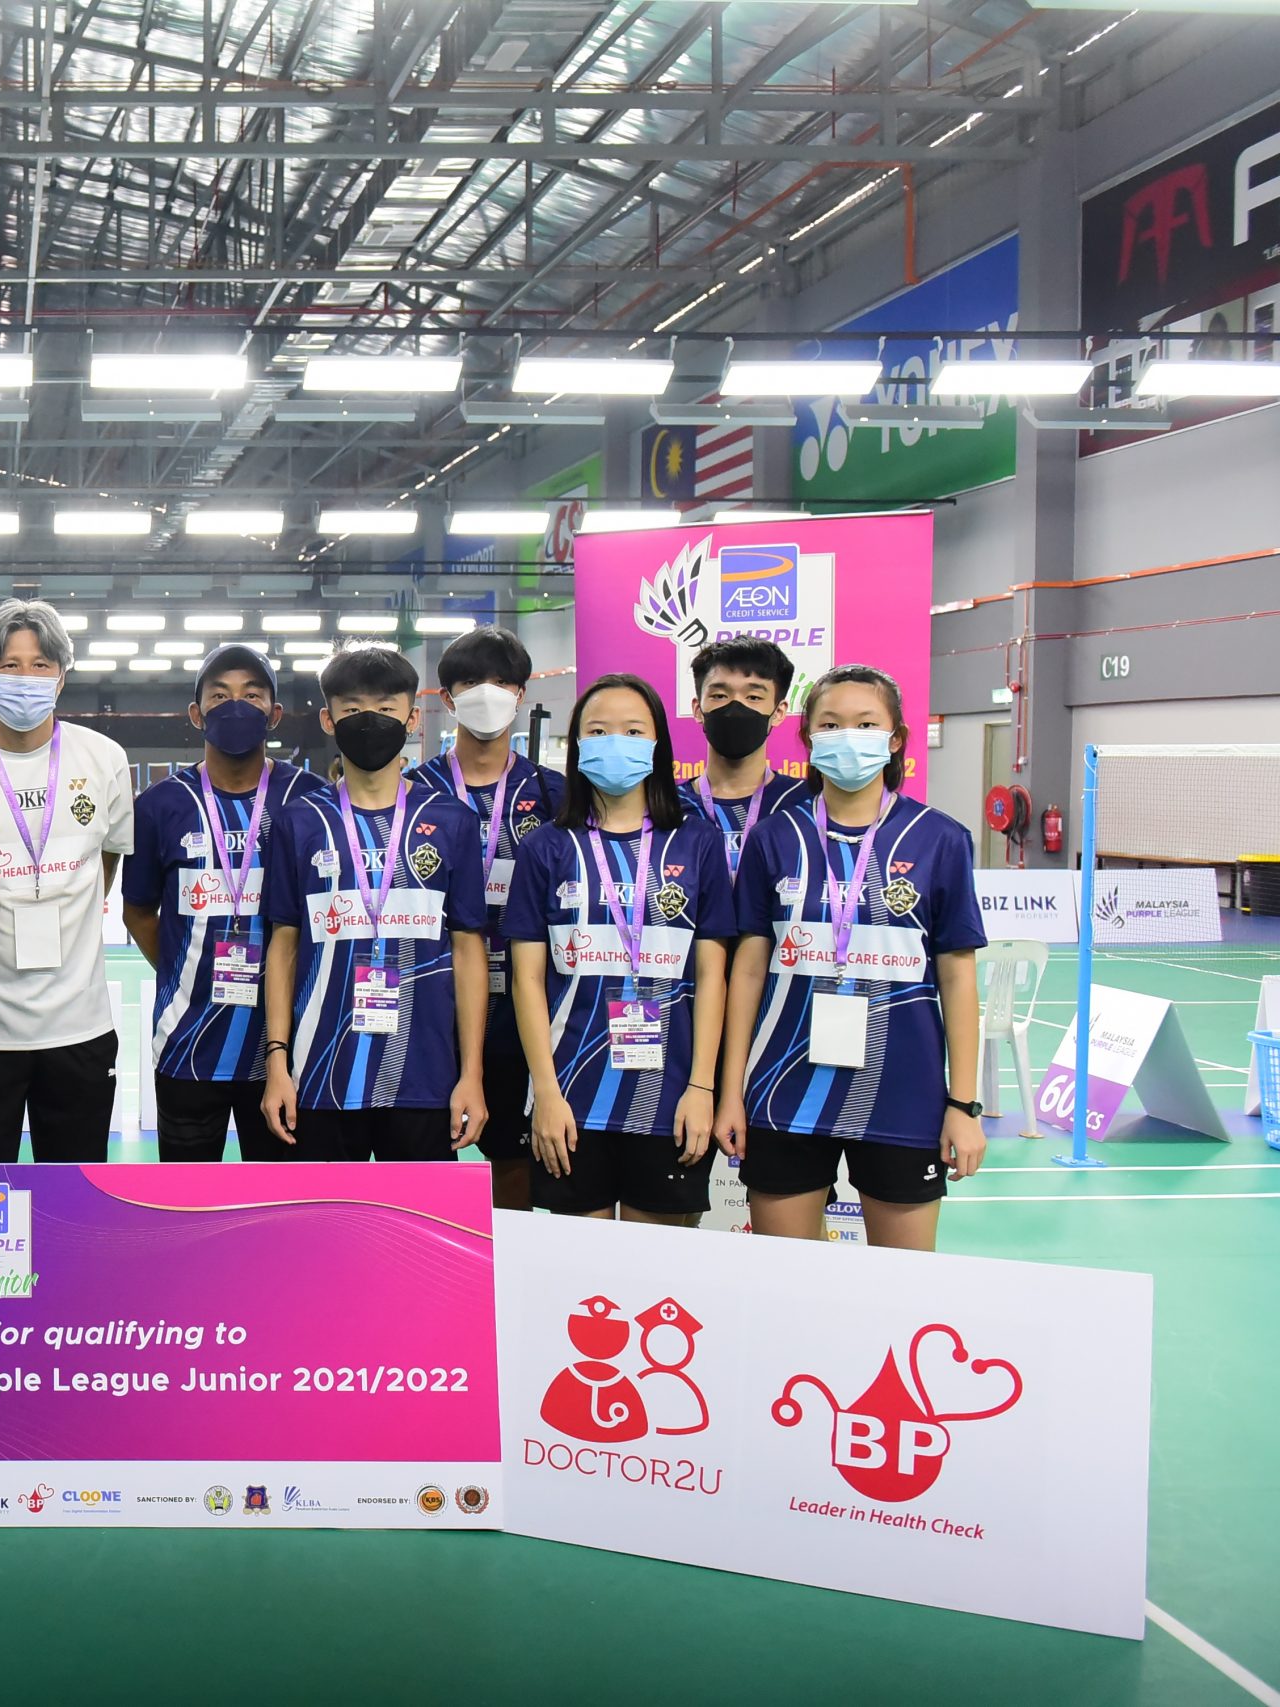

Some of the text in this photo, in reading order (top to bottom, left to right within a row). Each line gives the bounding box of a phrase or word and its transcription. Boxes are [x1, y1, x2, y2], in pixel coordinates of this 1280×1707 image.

[725, 608, 790, 618] CREDIT SERVICE
[1102, 655, 1130, 678] C19
[671, 759, 705, 779] 2nd
[189, 892, 261, 905] BP HEALHCA
[982, 896, 1057, 911] BIZ LINK
[1135, 900, 1189, 909] MALAYSIA
[1125, 909, 1200, 918] PURPLE LEAGUE
[325, 916, 341, 929] BP
[343, 914, 411, 926] HEALHCARE
[580, 950, 652, 964] HEALTHCRE
[780, 948, 921, 968] BP HEALTCARE GROUP
[715, 1178, 726, 1186] IN
[826, 1203, 862, 1214] GLOV
[829, 1230, 859, 1240] ONE
[43, 1320, 205, 1350] qualifying
[215, 1323, 247, 1347] to
[53, 1367, 170, 1397] League
[181, 1365, 282, 1393] Junior
[293, 1366, 470, 1395] 2021/2022
[835, 1411, 949, 1476] BP
[523, 1438, 723, 1496] DOCTOR2U
[62, 1490, 122, 1502] CLOONE
[27, 1499, 44, 1508] BP
[789, 1496, 985, 1540] Leader in Health Check
